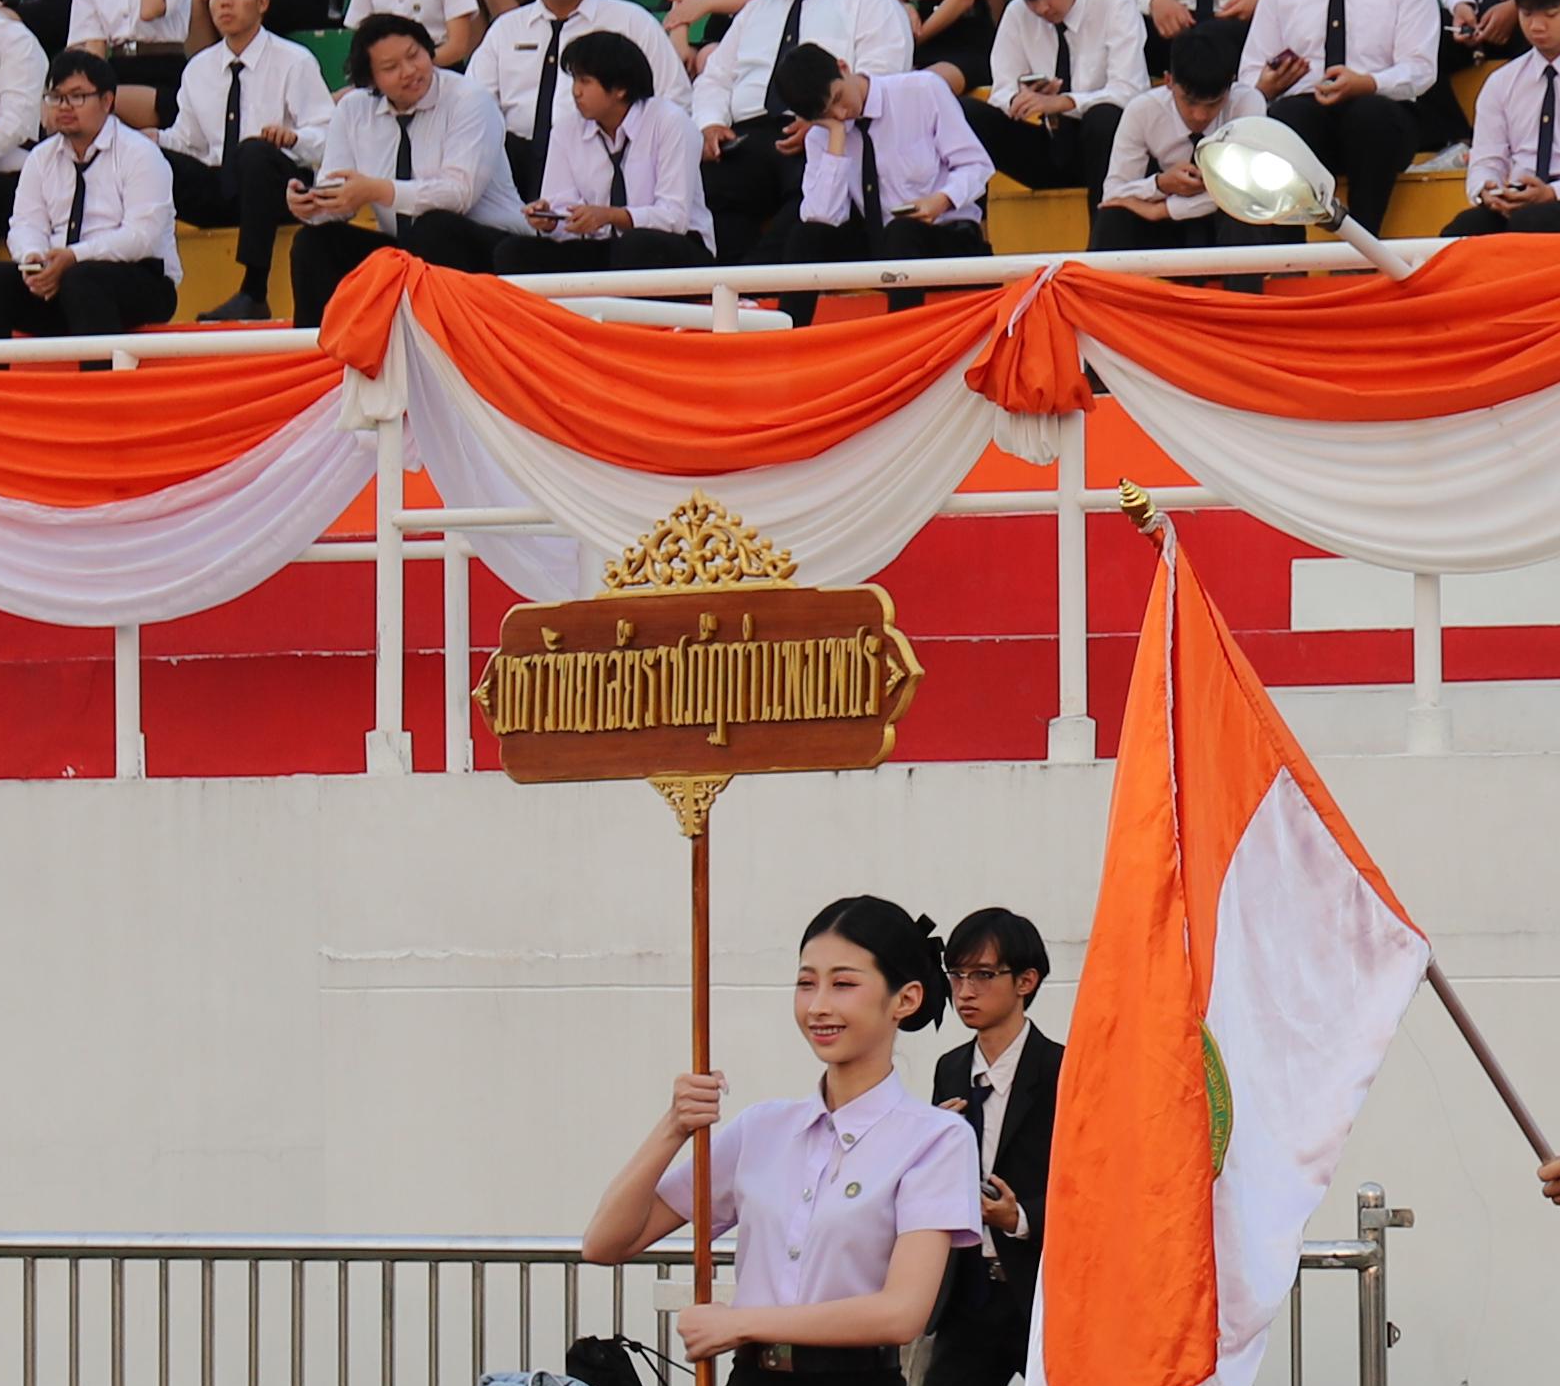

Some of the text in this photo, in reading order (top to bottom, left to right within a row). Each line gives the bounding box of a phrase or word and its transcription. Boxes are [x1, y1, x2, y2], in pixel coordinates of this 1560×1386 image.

[494, 612, 882, 746] มหาวิทยาลัยราชภัฏกำแพงเพชร
